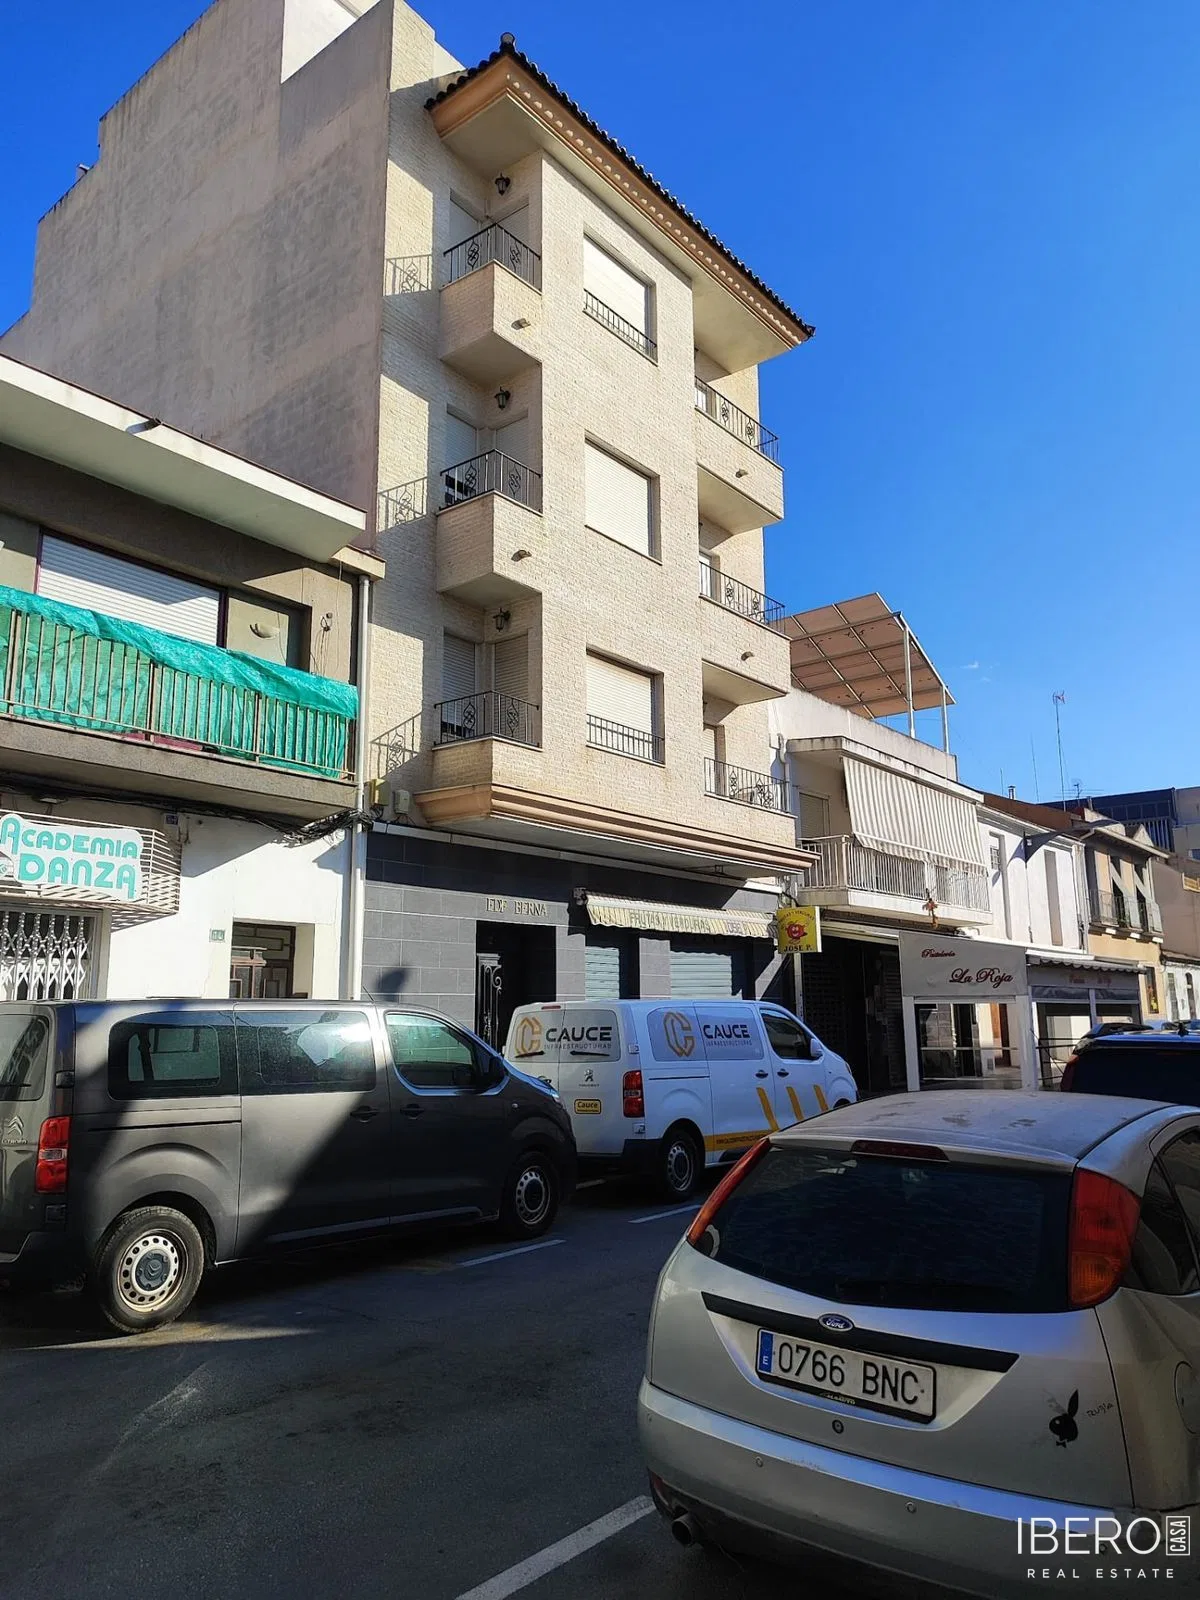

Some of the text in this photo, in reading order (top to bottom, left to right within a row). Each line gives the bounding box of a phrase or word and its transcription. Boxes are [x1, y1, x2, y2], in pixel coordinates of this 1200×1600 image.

[0, 817, 139, 859] ACADEMIA
[18, 853, 136, 899] DANZA
[514, 900, 548, 917] BERNA
[629, 911, 661, 927] FRUTAS
[669, 915, 711, 931] VERDURAS
[949, 967, 1014, 989] La Roja
[545, 1026, 613, 1043] CAUCE
[703, 1024, 751, 1040] CAUCE
[577, 1101, 598, 1109] Cauce
[825, 1317, 846, 1330] Ford
[762, 1354, 769, 1365] E
[778, 1342, 919, 1405] 0766 BNC
